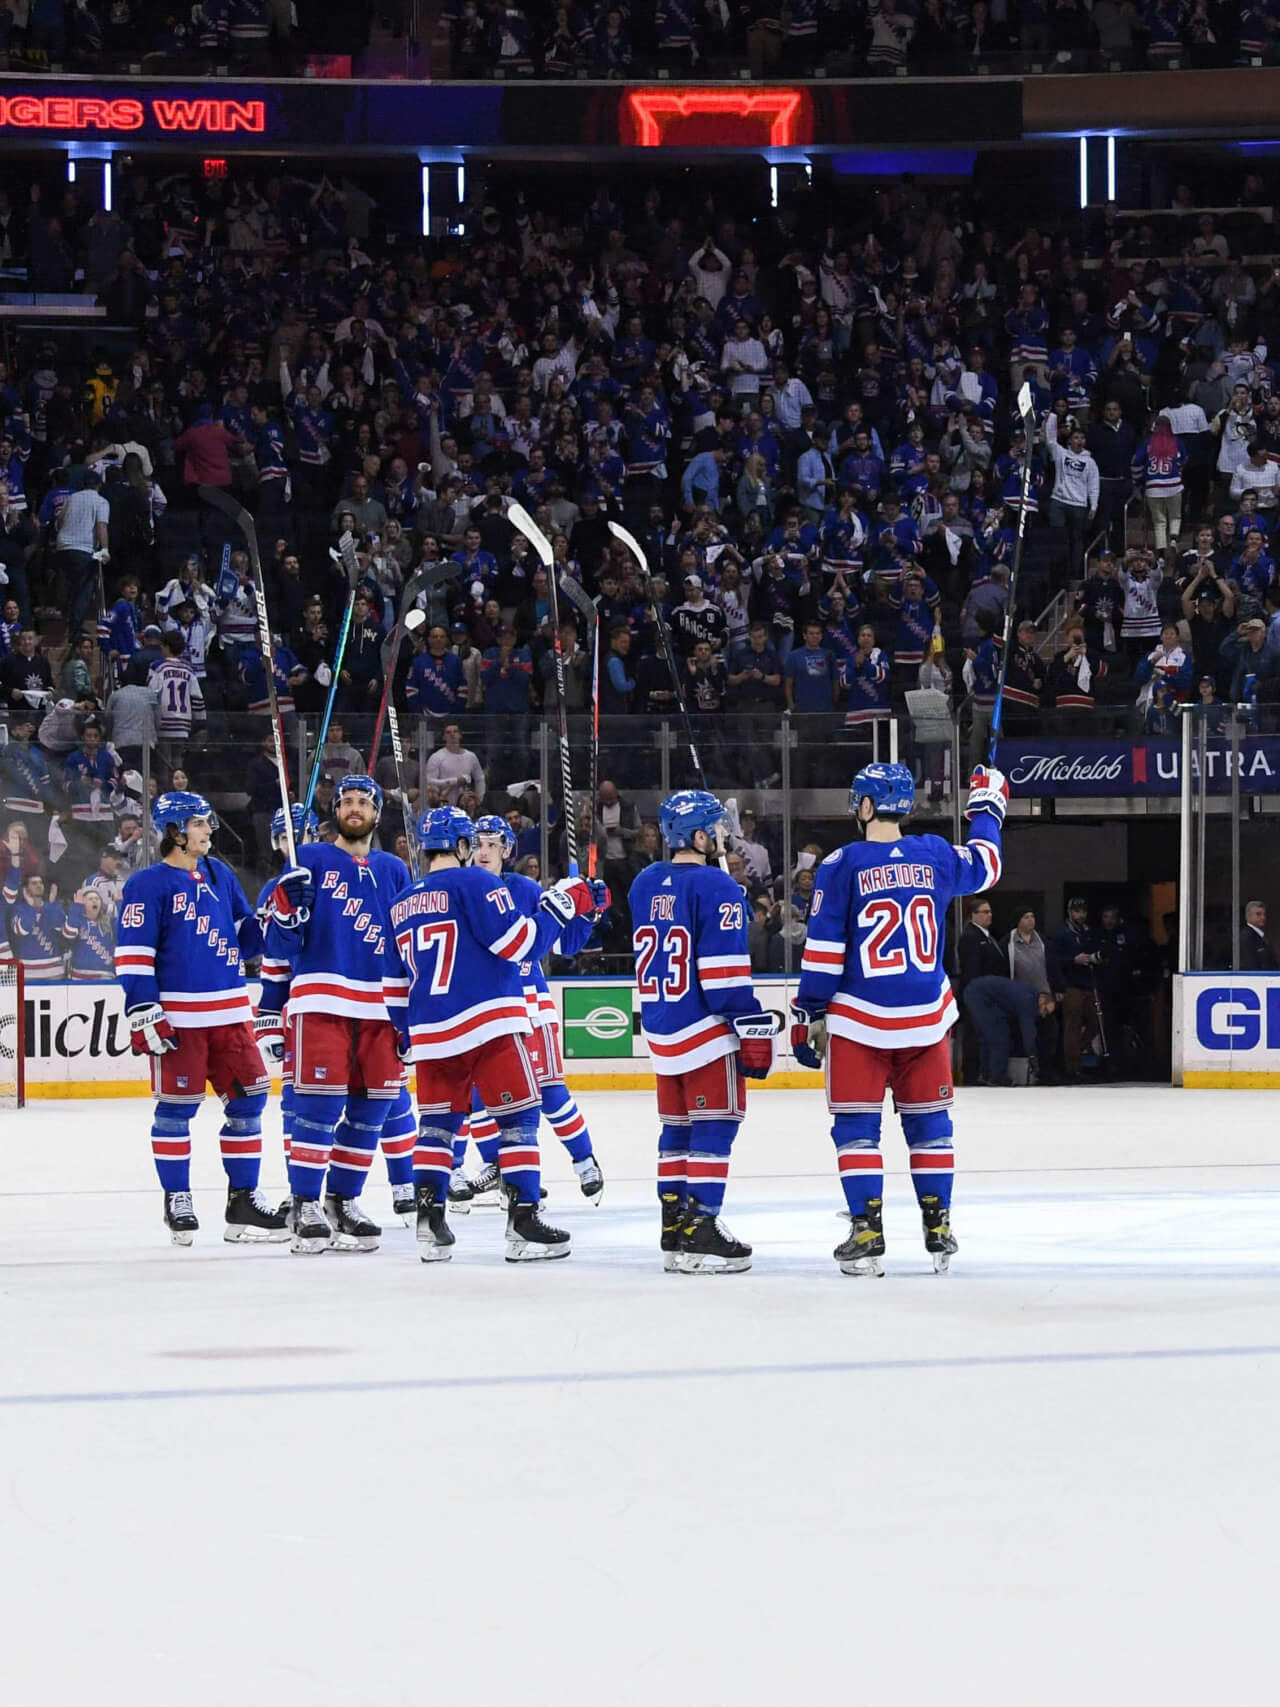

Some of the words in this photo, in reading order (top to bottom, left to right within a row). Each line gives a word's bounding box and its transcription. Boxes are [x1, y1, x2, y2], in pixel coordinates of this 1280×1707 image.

[152, 99, 265, 131] WIN
[204, 159, 228, 177] EXIT
[255, 590, 272, 658] BAUER
[167, 680, 188, 713] 11
[388, 706, 404, 762] BAUER
[1010, 754, 1126, 784] Michelob
[858, 864, 935, 896] KREIDER
[390, 890, 449, 928] VATRANO
[486, 887, 516, 914] 77
[650, 895, 676, 921] FOX
[718, 903, 743, 930] 23
[121, 903, 145, 937] 45
[857, 894, 938, 978] 20
[395, 919, 458, 996] 77
[633, 925, 692, 1003] 23
